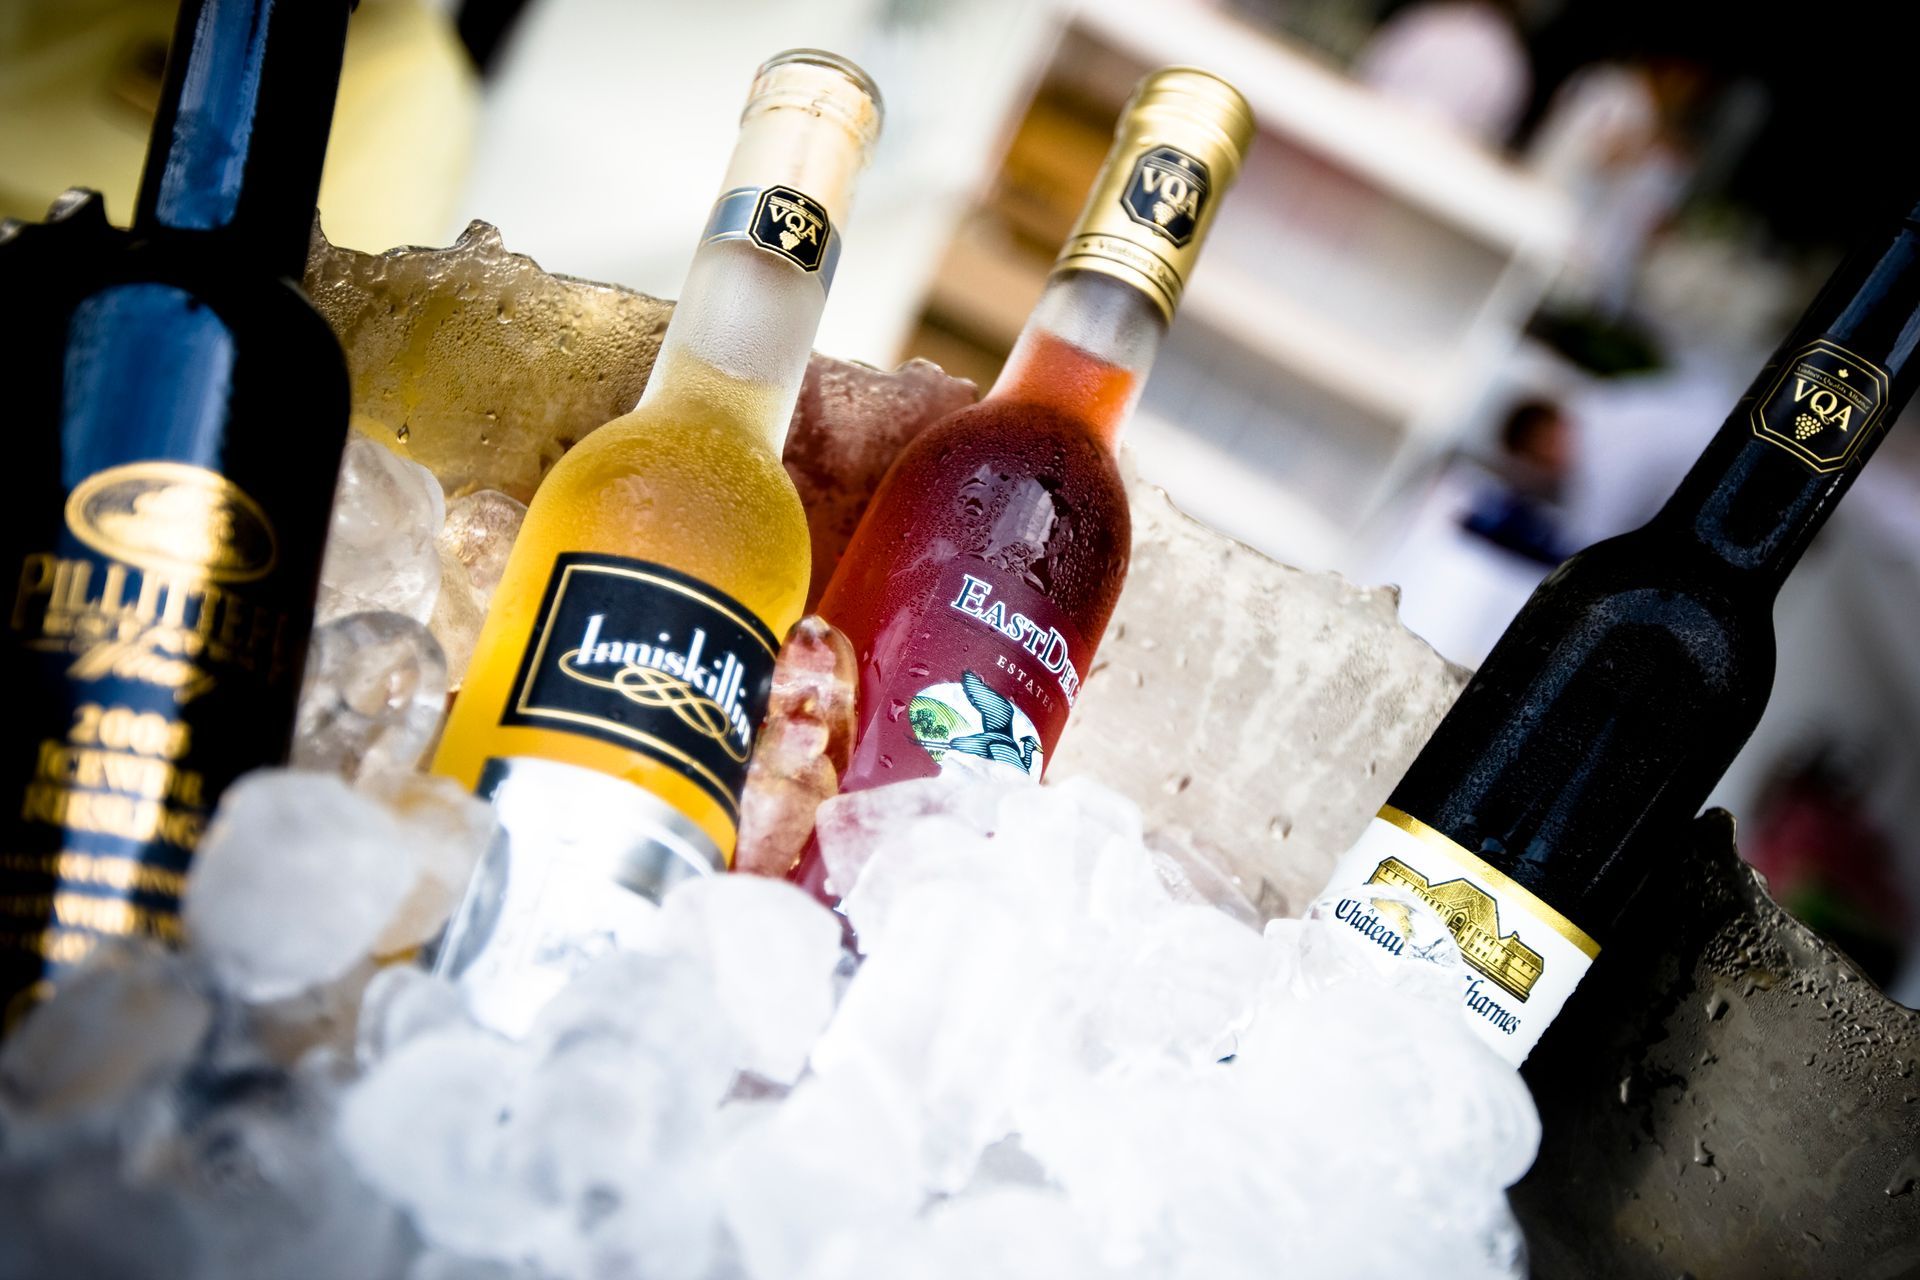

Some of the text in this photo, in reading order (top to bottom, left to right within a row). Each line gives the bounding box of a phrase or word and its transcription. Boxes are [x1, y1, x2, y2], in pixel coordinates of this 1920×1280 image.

[1141, 166, 1200, 220] VQA
[768, 203, 817, 246] VQA
[1794, 378, 1852, 432] VQA
[576, 613, 751, 747] Inniskillin
[996, 655, 1054, 713] ESTATES
[1335, 898, 1406, 956] Château
[1464, 975, 1521, 1035] harmes
